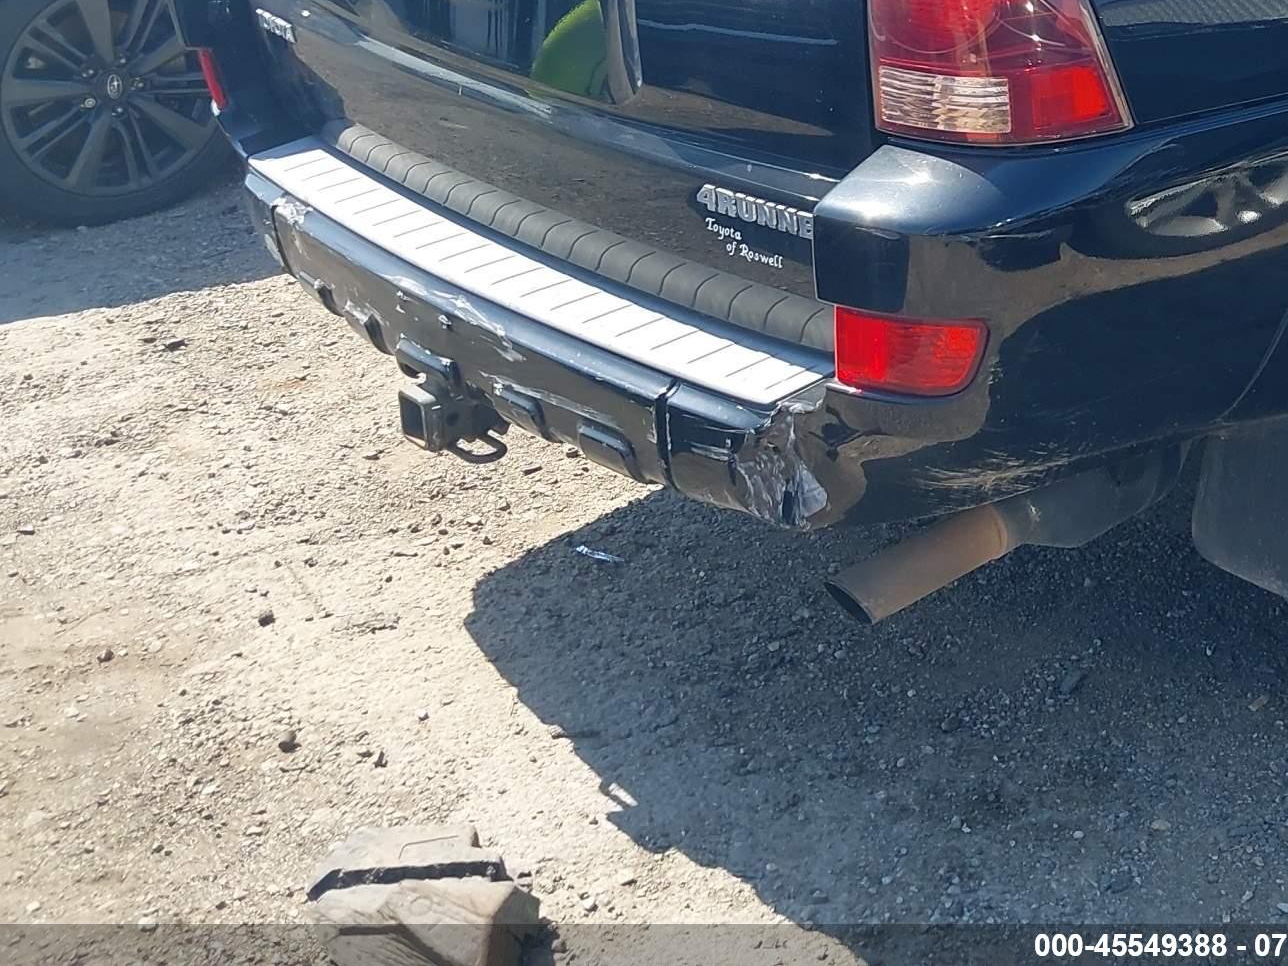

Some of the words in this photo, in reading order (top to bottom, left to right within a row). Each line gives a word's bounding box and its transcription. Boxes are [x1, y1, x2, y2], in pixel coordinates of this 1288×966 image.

[704, 216, 743, 240] Toyota
[726, 241, 737, 256] of
[739, 243, 784, 269] Roswell
